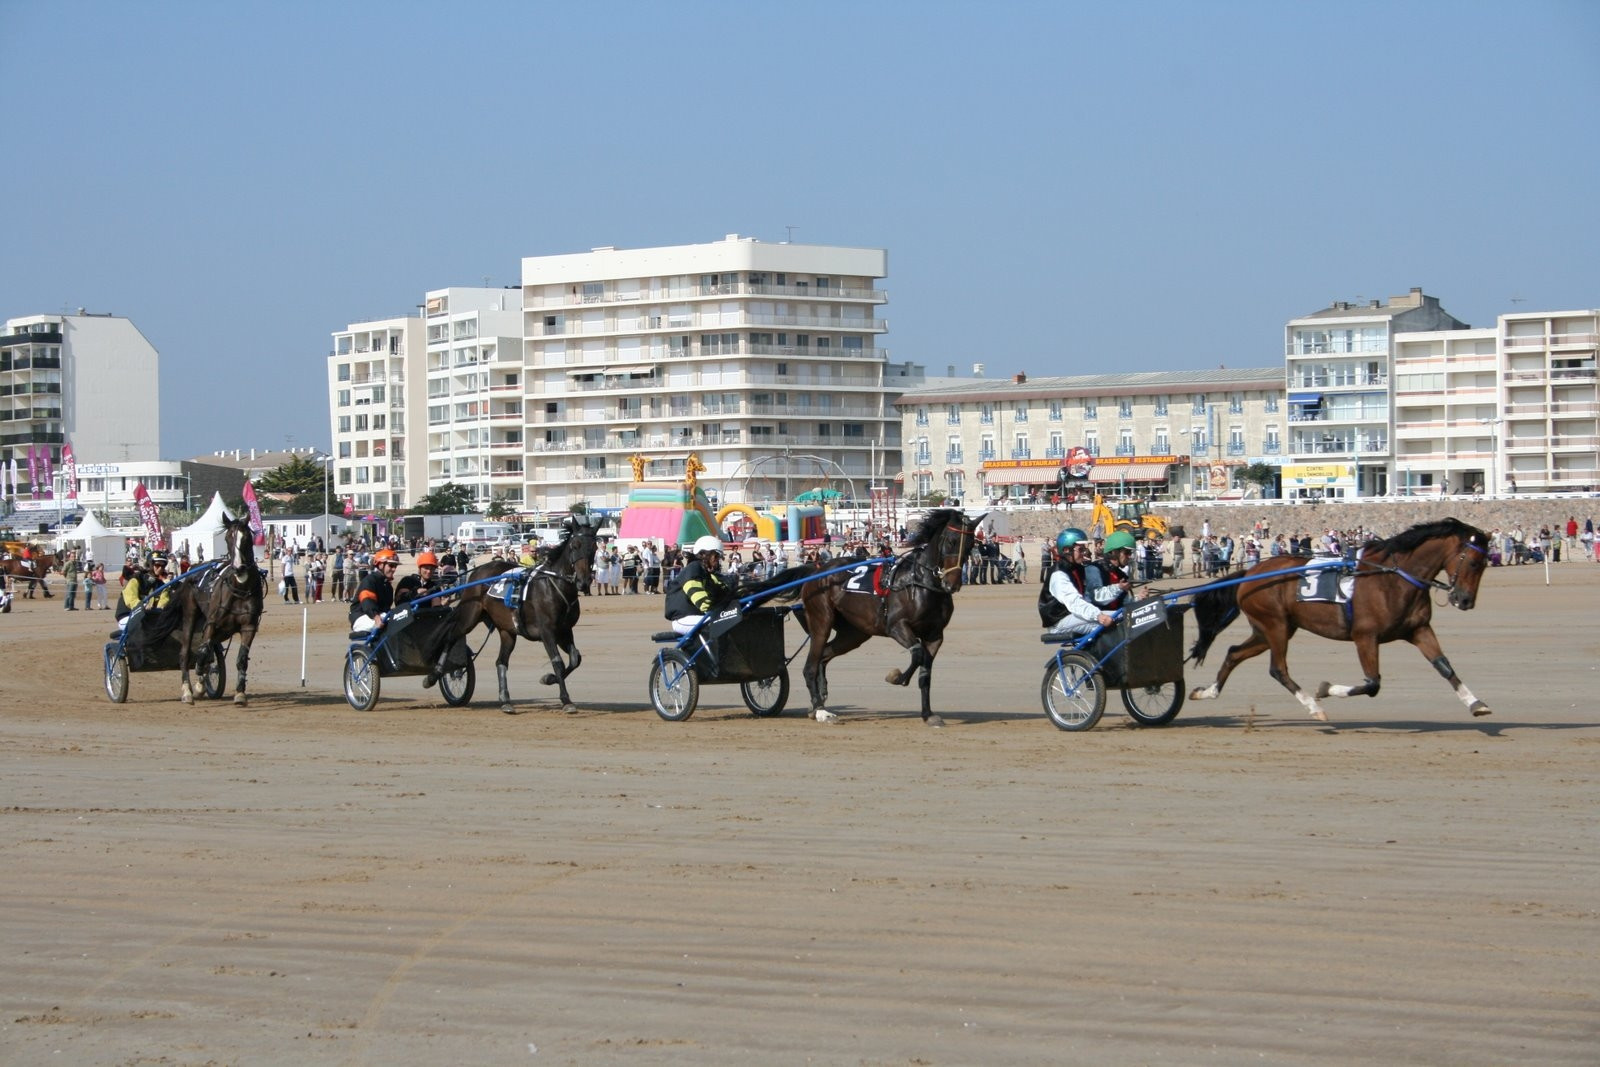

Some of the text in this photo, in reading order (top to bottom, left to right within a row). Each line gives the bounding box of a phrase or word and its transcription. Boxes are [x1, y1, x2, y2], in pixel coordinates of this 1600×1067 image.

[983, 459, 1061, 468] BRASSERIE RESTAURANT
[1095, 457, 1130, 465] BRASSERIE
[1134, 456, 1176, 464] RESTAURANT
[494, 577, 508, 594] 4
[847, 565, 869, 589] 2
[1301, 570, 1322, 597] 3
